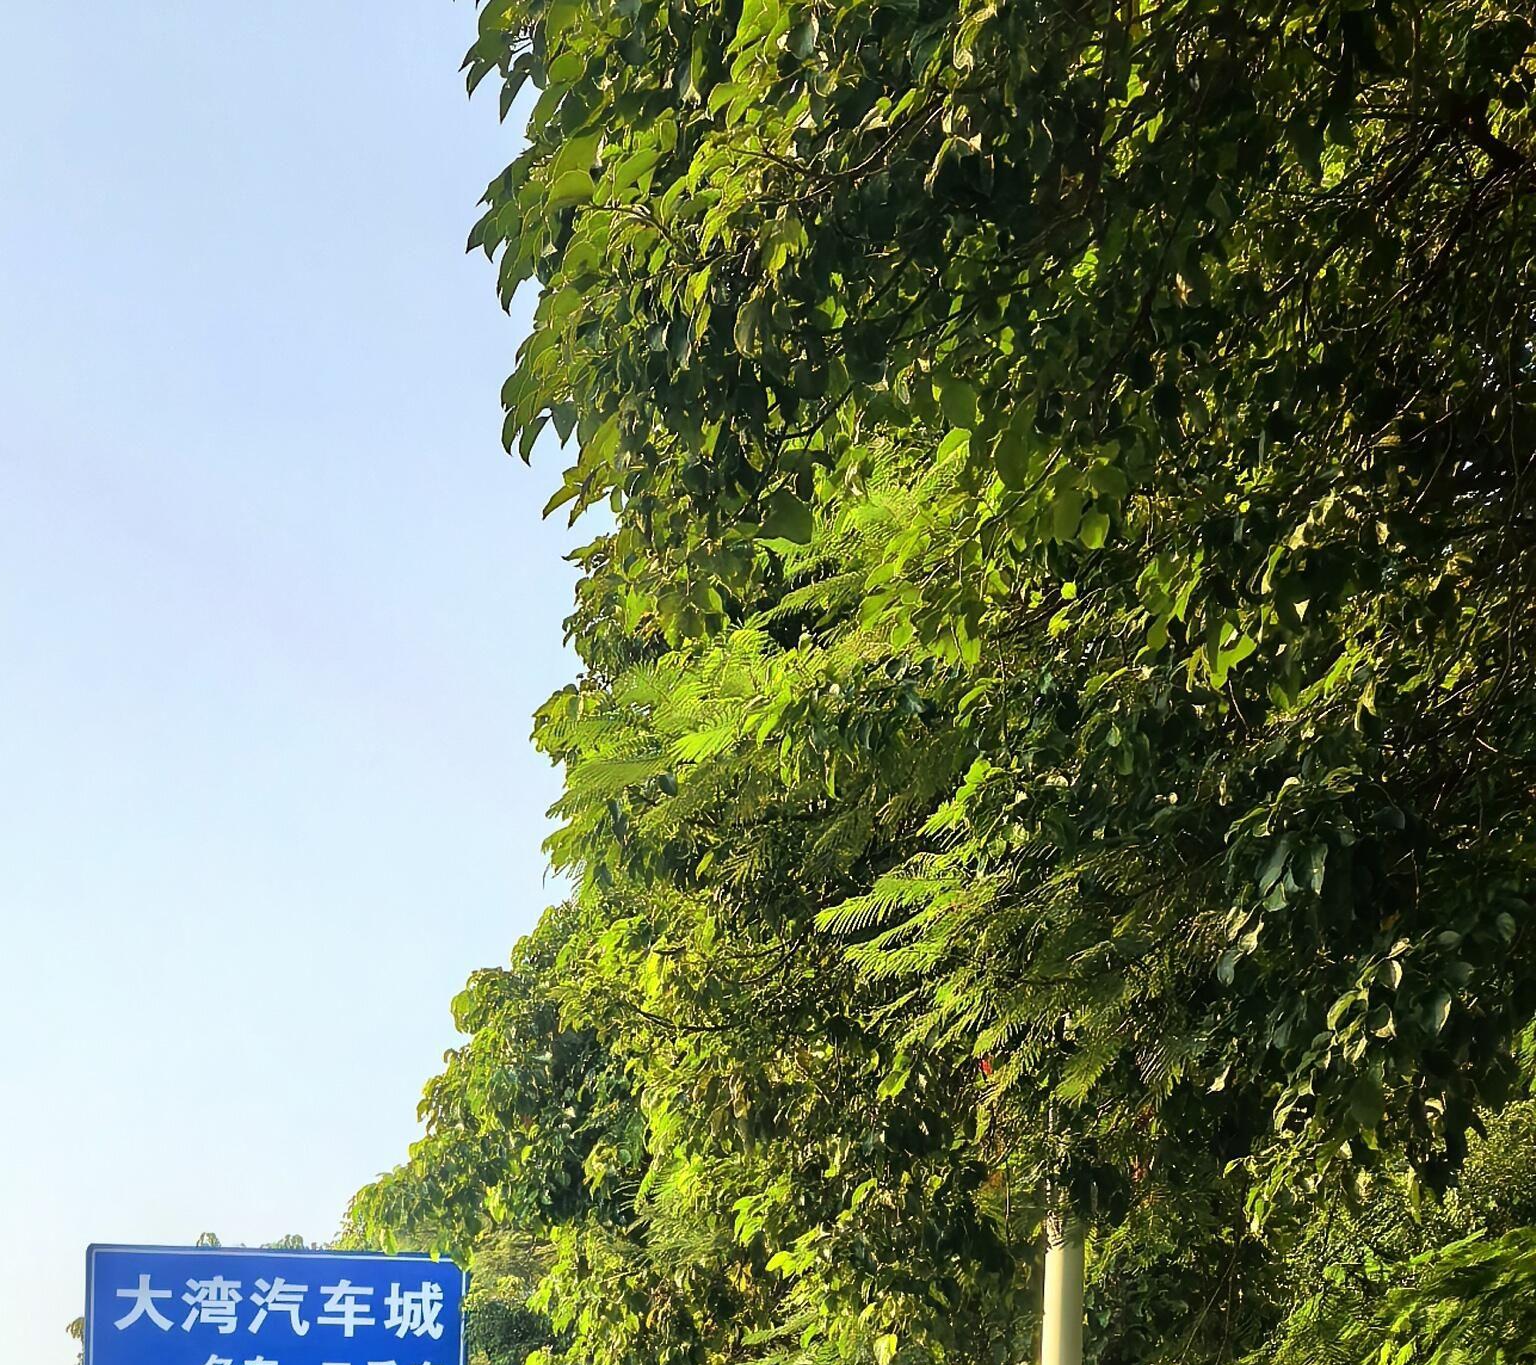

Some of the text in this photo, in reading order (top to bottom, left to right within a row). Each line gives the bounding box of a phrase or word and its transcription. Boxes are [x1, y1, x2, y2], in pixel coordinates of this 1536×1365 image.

[112, 1273, 445, 1340] 大湾汽车城
